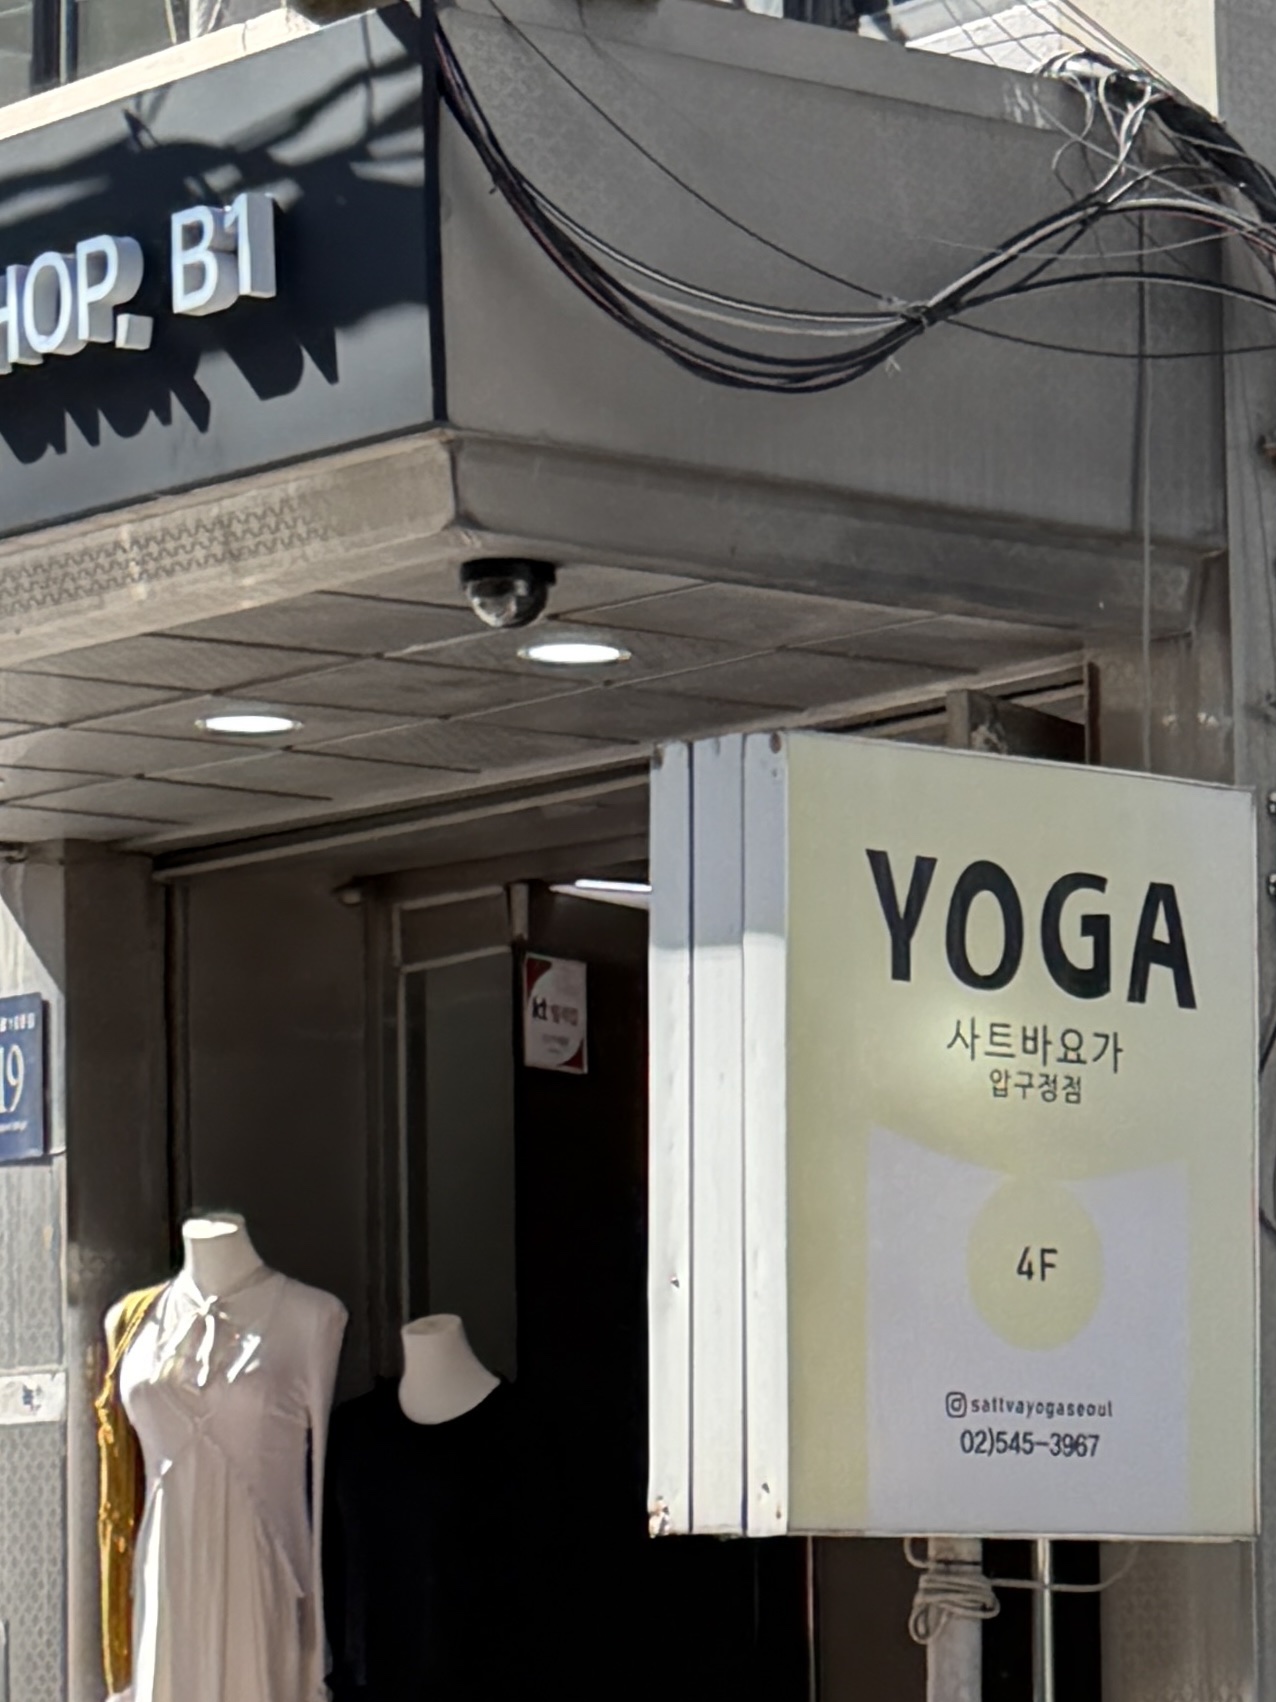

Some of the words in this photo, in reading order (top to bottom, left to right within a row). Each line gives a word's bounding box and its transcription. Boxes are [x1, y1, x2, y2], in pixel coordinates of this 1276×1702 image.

[171, 192, 276, 316] B1
[865, 848, 1197, 1010] YOGA
[946, 1016, 1124, 1074] 사트바요가
[989, 1068, 1083, 1104] 압구정점
[1016, 1246, 1058, 1282] 4F
[960, 1427, 1100, 1457] 02)545-3967
